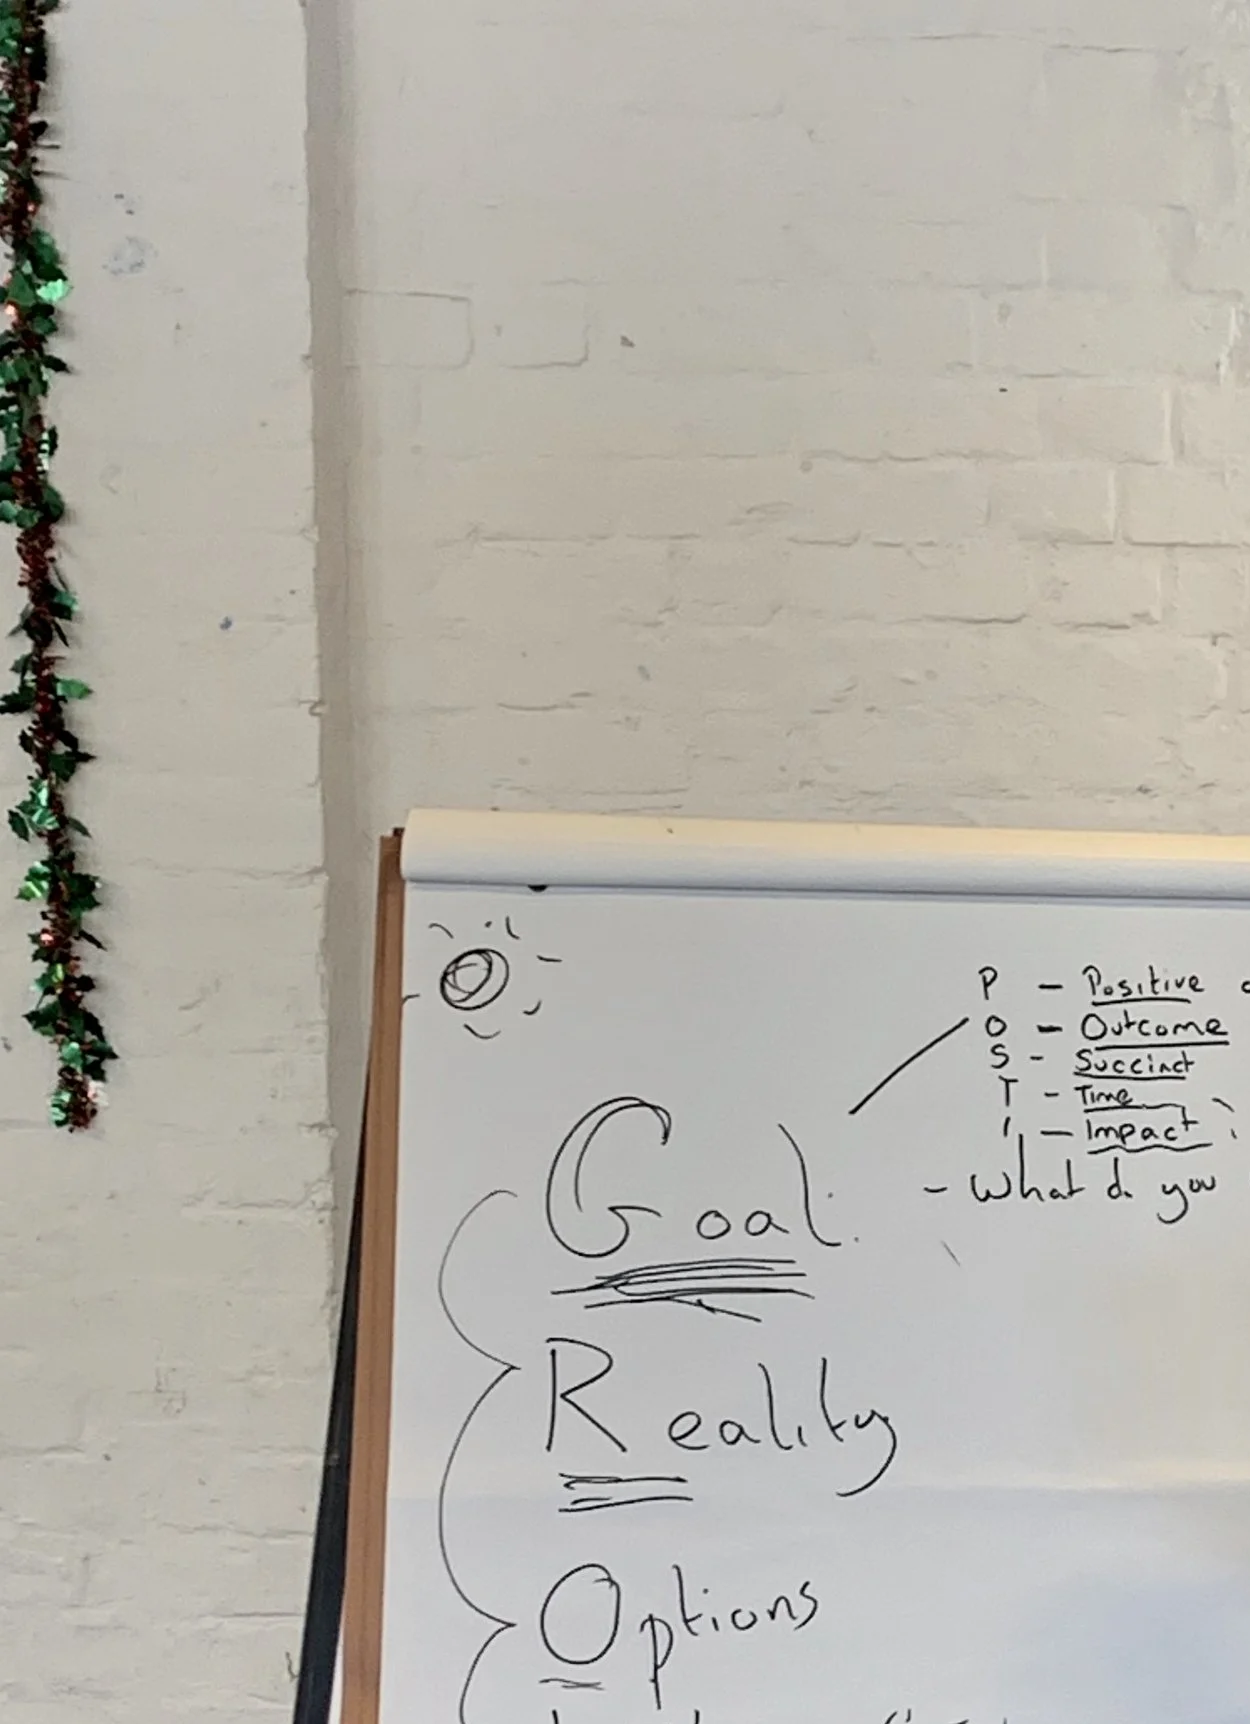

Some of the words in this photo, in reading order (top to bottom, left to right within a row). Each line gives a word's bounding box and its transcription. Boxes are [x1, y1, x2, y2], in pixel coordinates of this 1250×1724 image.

[977, 965, 999, 1001] P
[1081, 964, 1205, 997] Positive
[984, 1014, 1008, 1038] O
[1080, 1009, 1230, 1041] Outcome
[989, 1043, 1010, 1069] S
[1076, 1048, 1195, 1075] Succinct
[997, 1074, 1020, 1107] T
[1073, 1084, 1134, 1106] Time
[1086, 1105, 1199, 1144] Impact
[1156, 1175, 1217, 1225] you
[545, 1336, 897, 1498] Reality
[540, 1563, 819, 1710] Options
